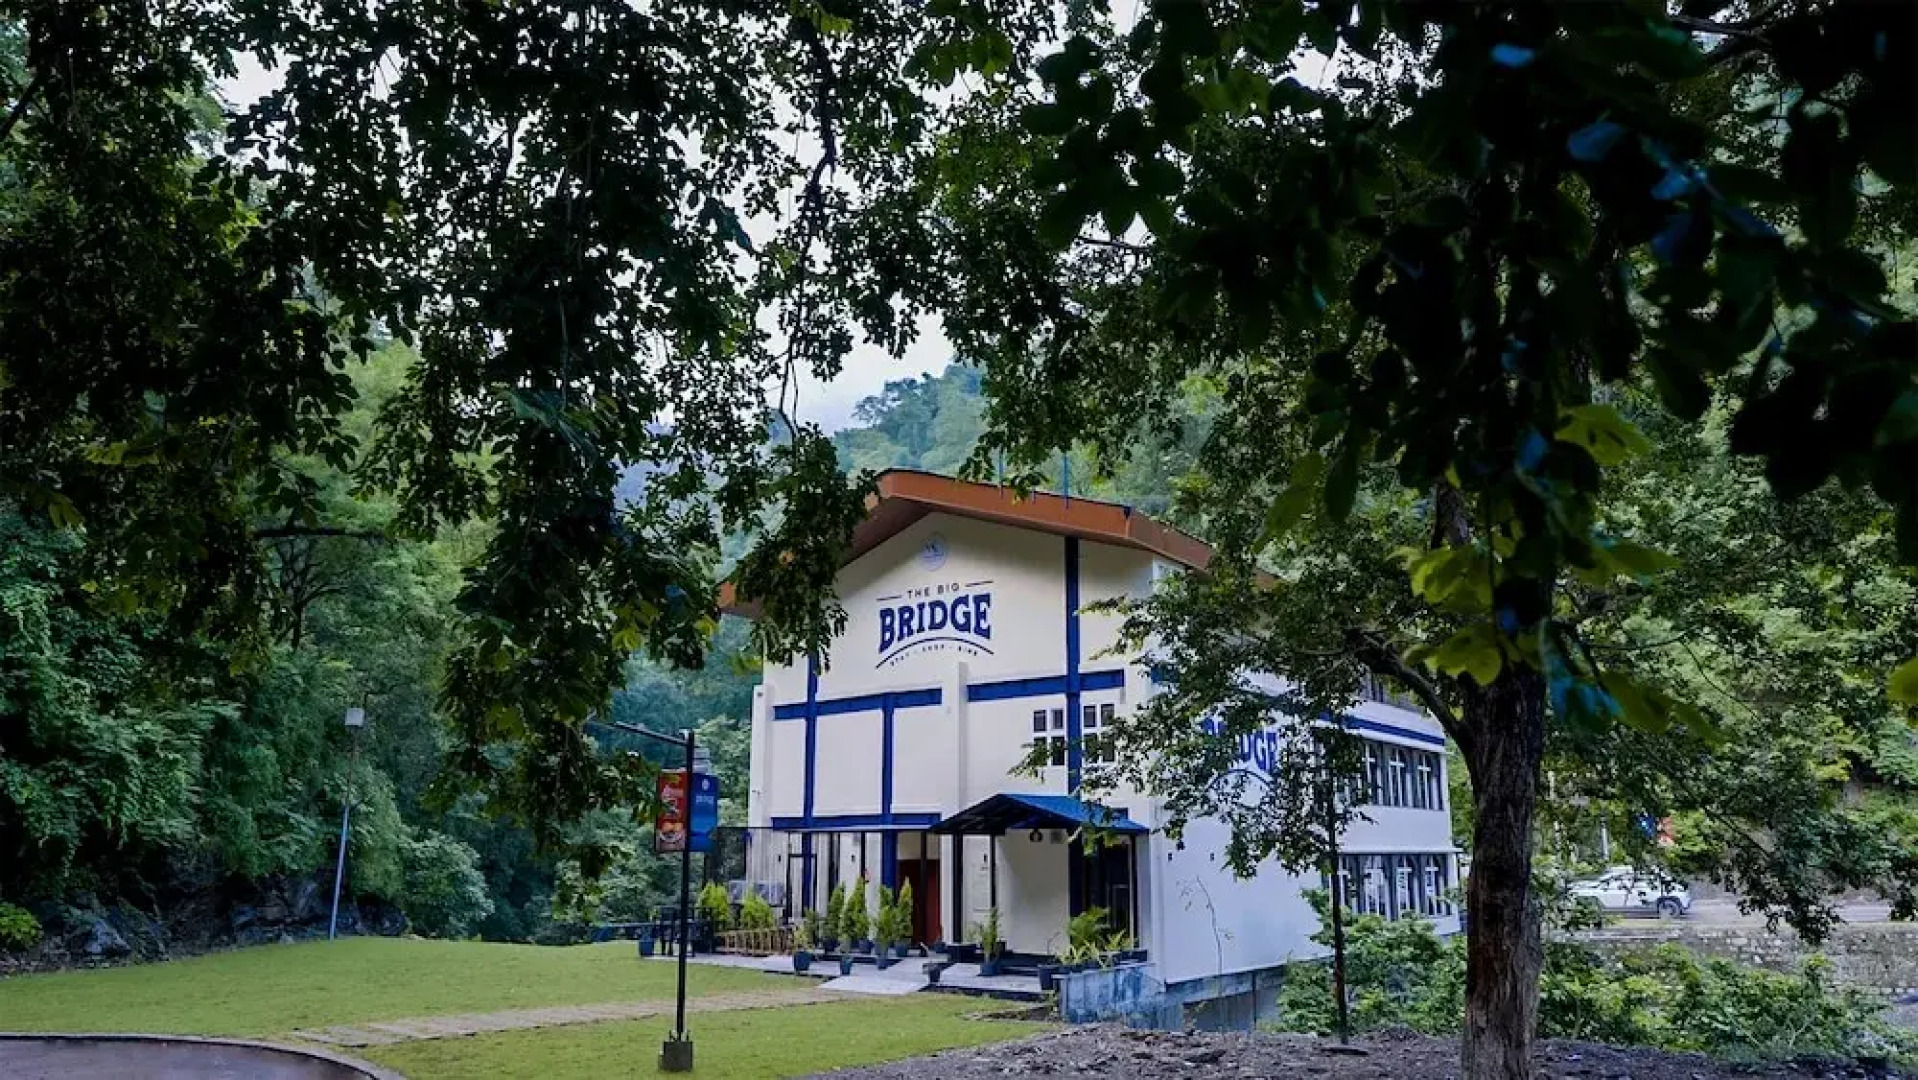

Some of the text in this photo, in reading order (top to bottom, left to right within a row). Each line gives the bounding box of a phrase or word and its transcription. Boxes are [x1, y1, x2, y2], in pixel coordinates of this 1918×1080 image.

[907, 583, 960, 599] THE BIG
[879, 593, 991, 654] BRIDGE
